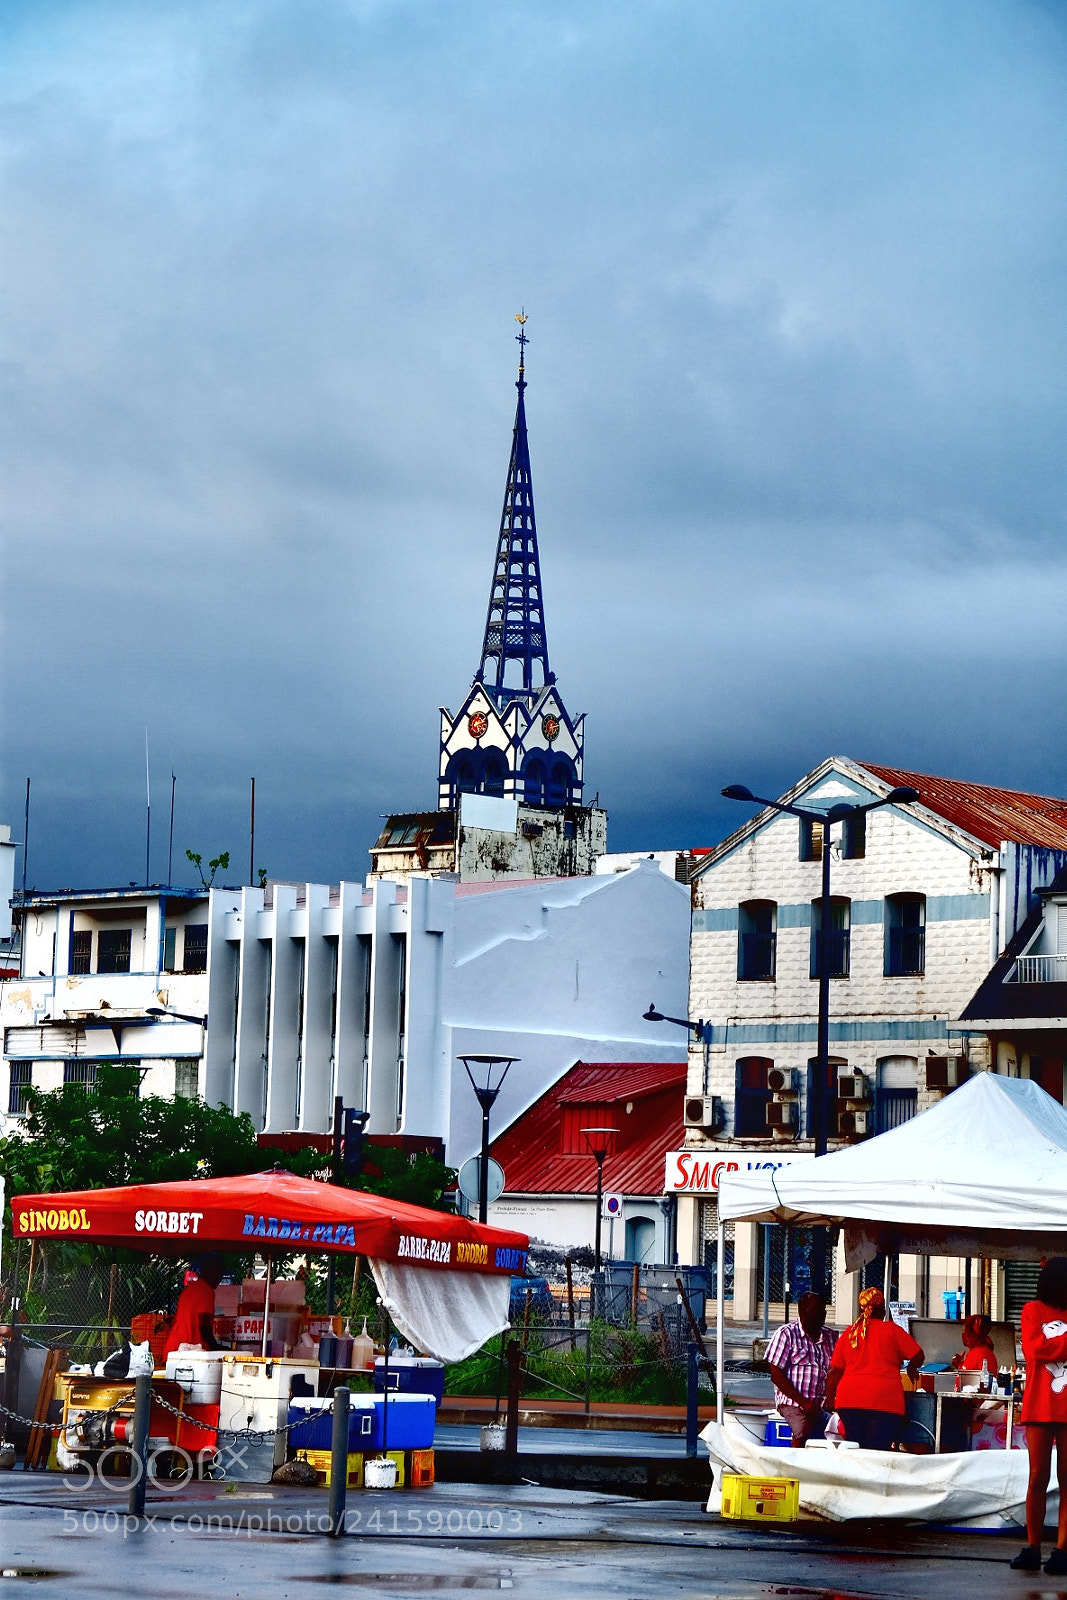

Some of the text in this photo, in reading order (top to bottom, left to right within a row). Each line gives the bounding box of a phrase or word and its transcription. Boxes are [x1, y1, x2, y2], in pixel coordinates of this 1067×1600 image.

[135, 1210, 204, 1234] SORBET
[242, 1214, 302, 1240] BARBE
[311, 1223, 356, 1247] PAPA
[397, 1235, 427, 1260] BARBE
[429, 1239, 451, 1263] PAPA
[495, 1247, 528, 1271] SORBET
